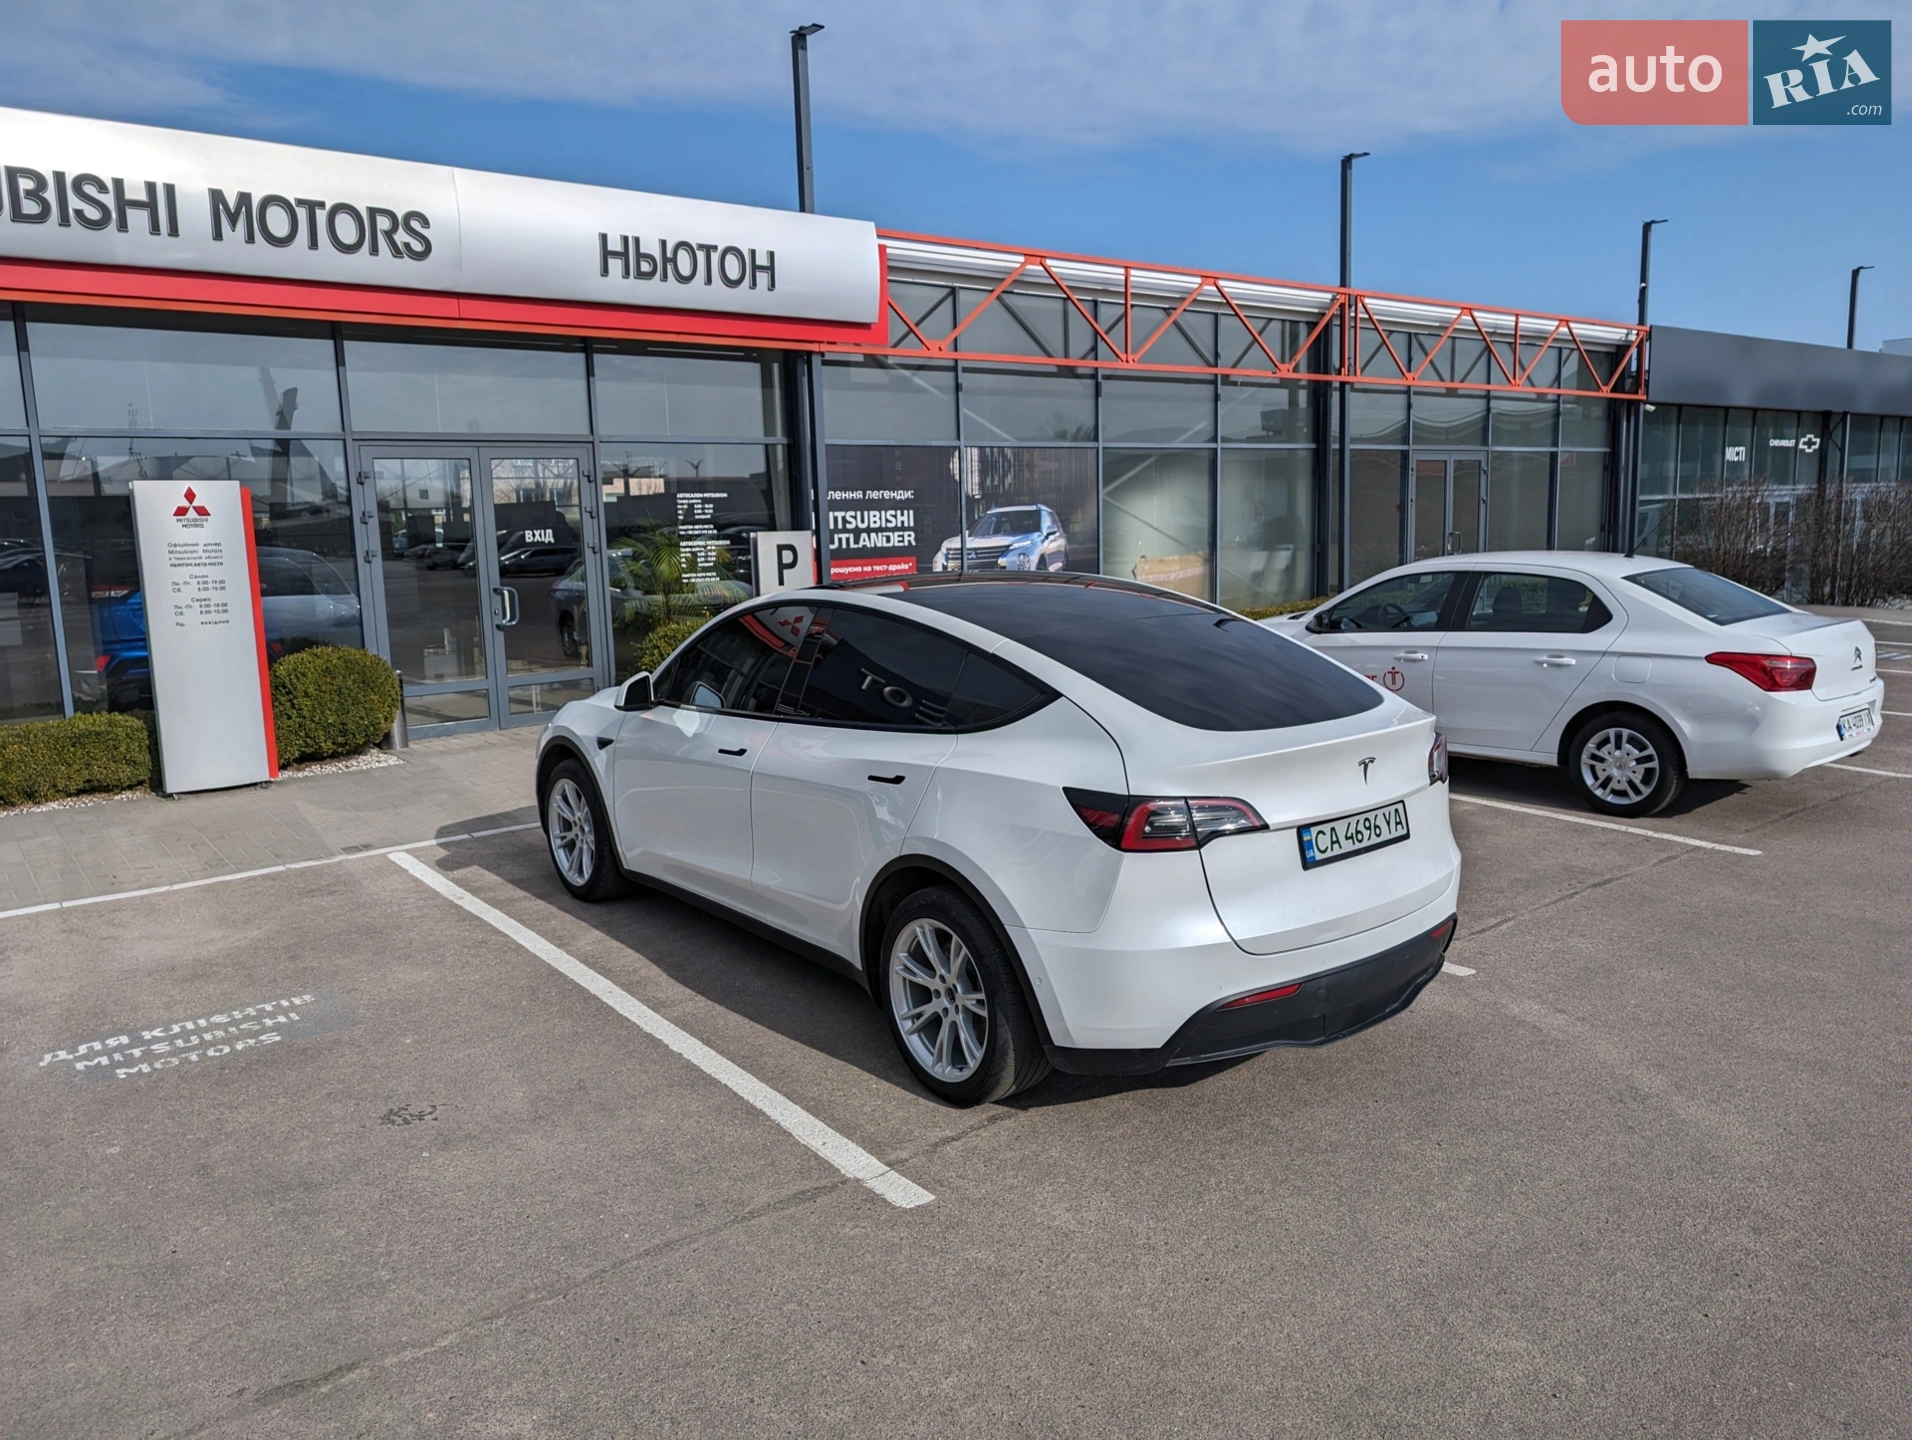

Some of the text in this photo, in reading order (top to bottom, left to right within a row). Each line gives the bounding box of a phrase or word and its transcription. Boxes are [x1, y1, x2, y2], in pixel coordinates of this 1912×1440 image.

[0, 165, 433, 261] BISHI MOTORS
[599, 231, 776, 291] НЬЮТОН
[1769, 439, 1796, 447] CHEVROLET
[827, 489, 914, 500] лення легенди:
[828, 510, 914, 529] ITSUBISHI
[525, 529, 554, 544] ВХІД
[776, 544, 799, 586] P
[830, 565, 861, 574] рошуємо
[1315, 808, 1404, 854] CA 4696 YA
[38, 1034, 130, 1067] ДЛЯ
[74, 1012, 301, 1072] MITSUBISHI
